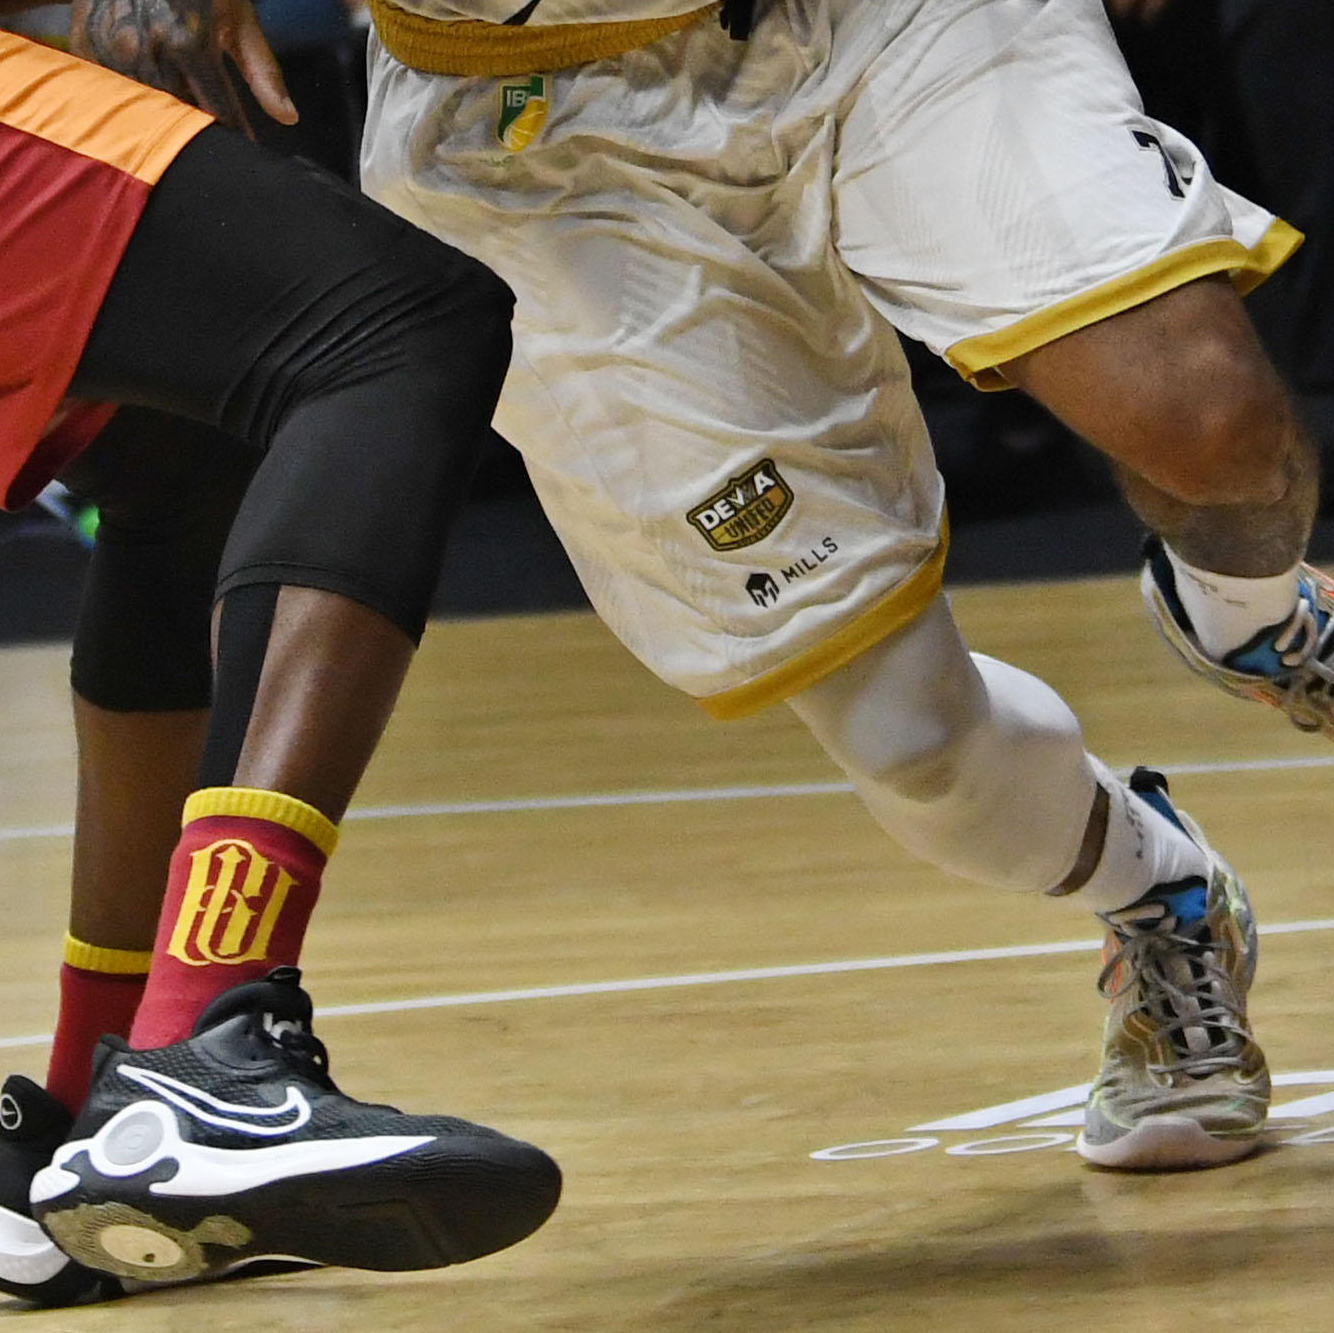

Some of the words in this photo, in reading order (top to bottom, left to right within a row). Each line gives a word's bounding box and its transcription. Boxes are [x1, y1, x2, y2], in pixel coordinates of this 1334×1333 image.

[506, 89, 528, 107] IB
[695, 469, 776, 532] DEWA
[723, 498, 777, 539] UNITED
[780, 536, 839, 584] MILLS
